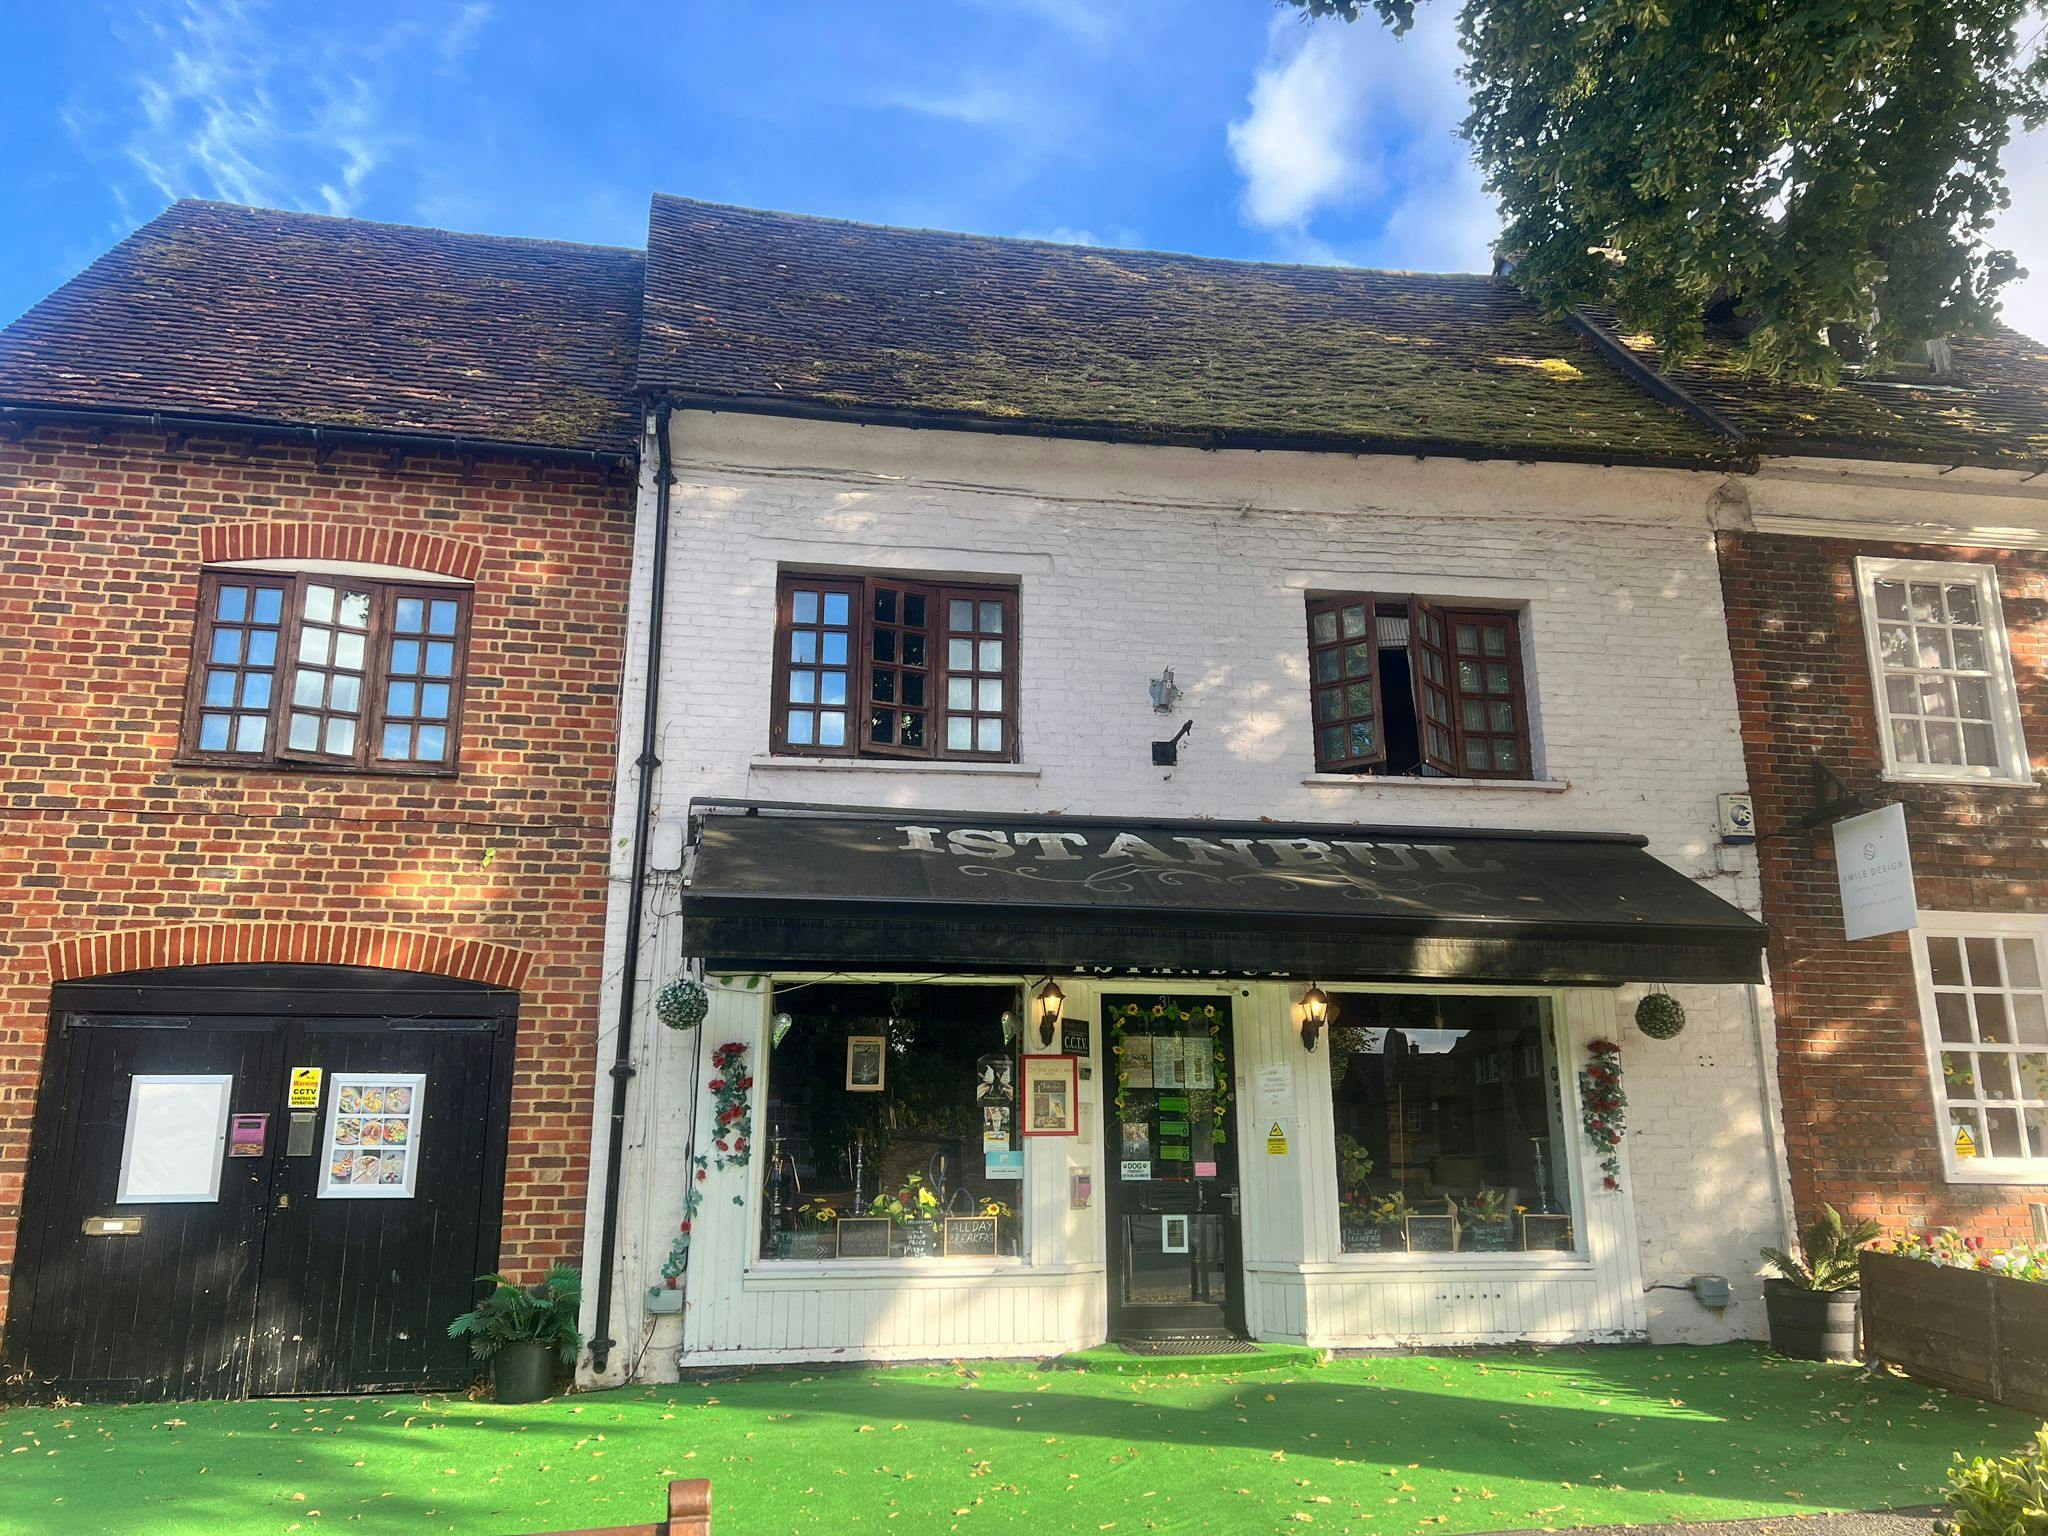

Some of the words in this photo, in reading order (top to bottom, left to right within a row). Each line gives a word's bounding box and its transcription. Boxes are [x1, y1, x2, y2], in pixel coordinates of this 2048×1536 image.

[895, 825, 1508, 874] ISTANBUL
[1843, 869, 1867, 883] SMILE
[1871, 861, 1904, 877] DESIGN
[293, 1080, 318, 1088] Warning
[1127, 1162, 1143, 1170] DOG
[951, 1222, 970, 1232] ALL
[971, 1221, 993, 1232] DAY
